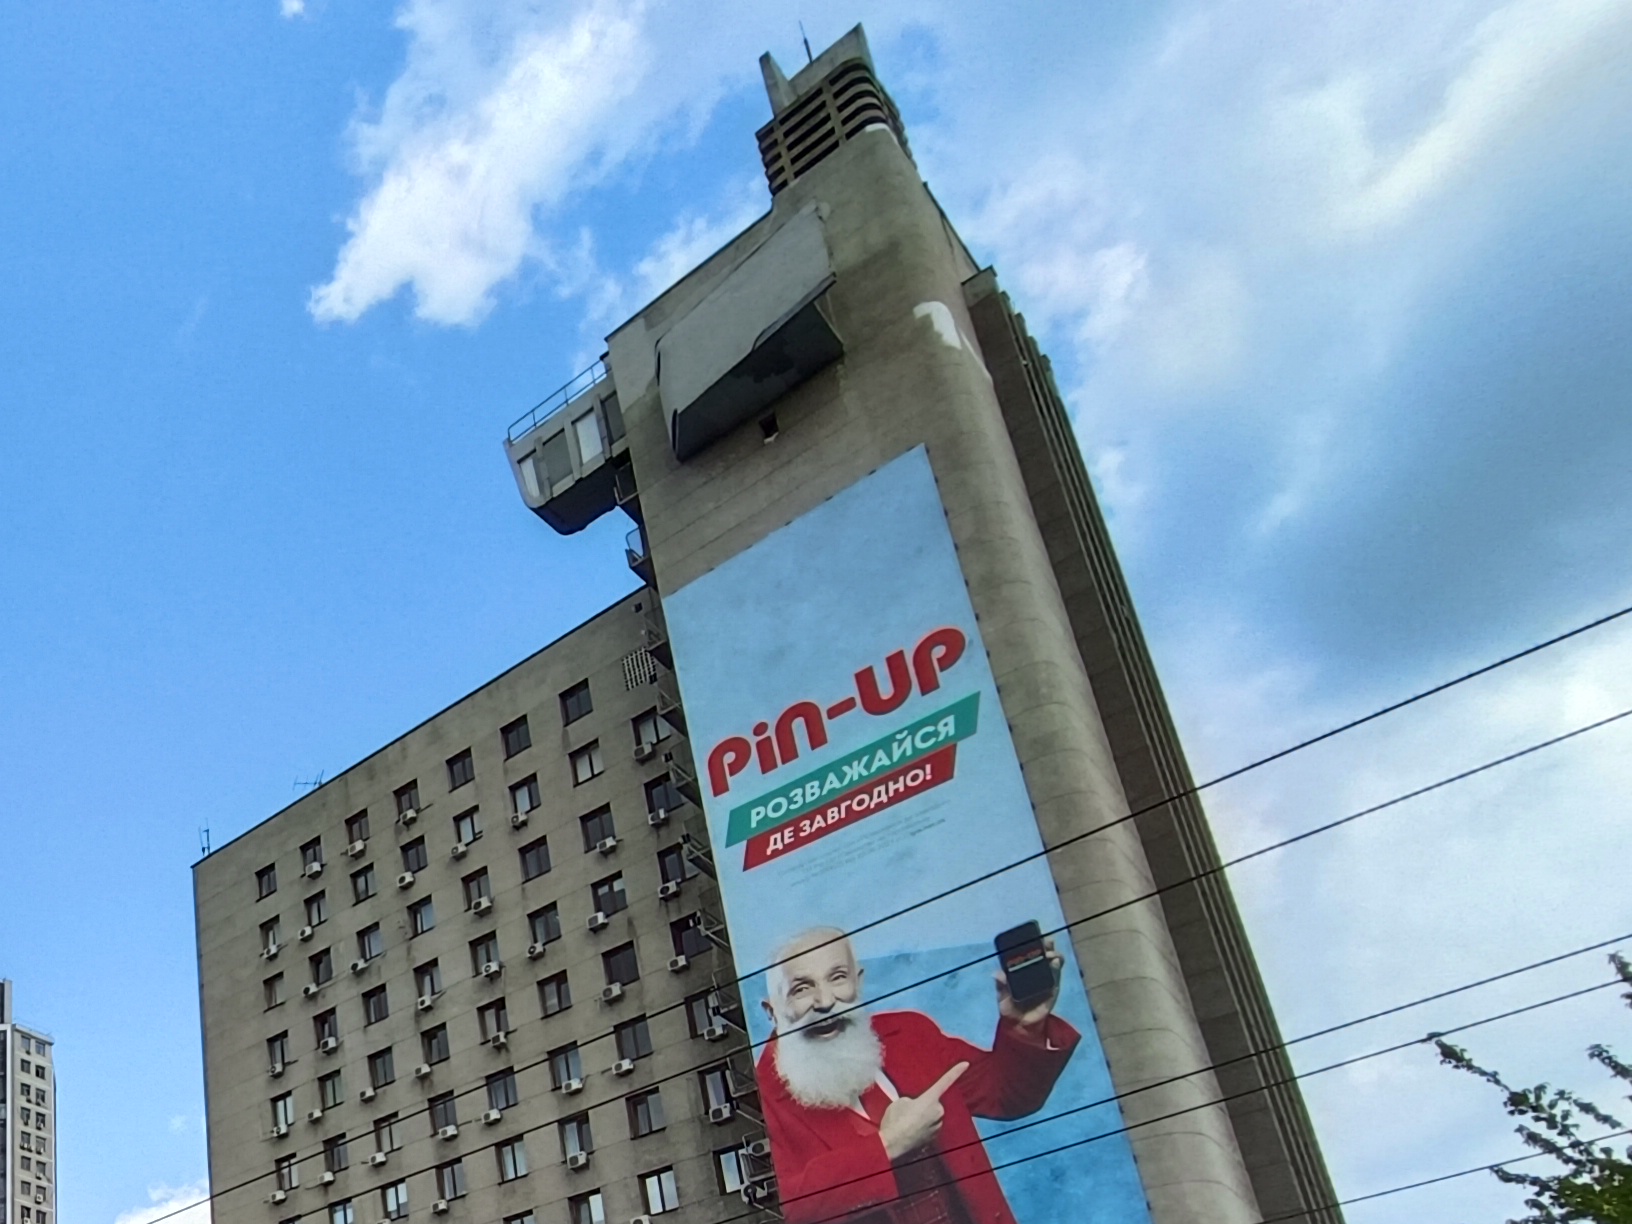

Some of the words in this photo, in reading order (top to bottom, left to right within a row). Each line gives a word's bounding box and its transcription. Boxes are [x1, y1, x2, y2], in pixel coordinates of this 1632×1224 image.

[750, 714, 956, 828] РОЗВАЖАЙСЯ
[766, 830, 795, 855] ДЕ
[799, 764, 932, 837] ЗАВГОДНО!
